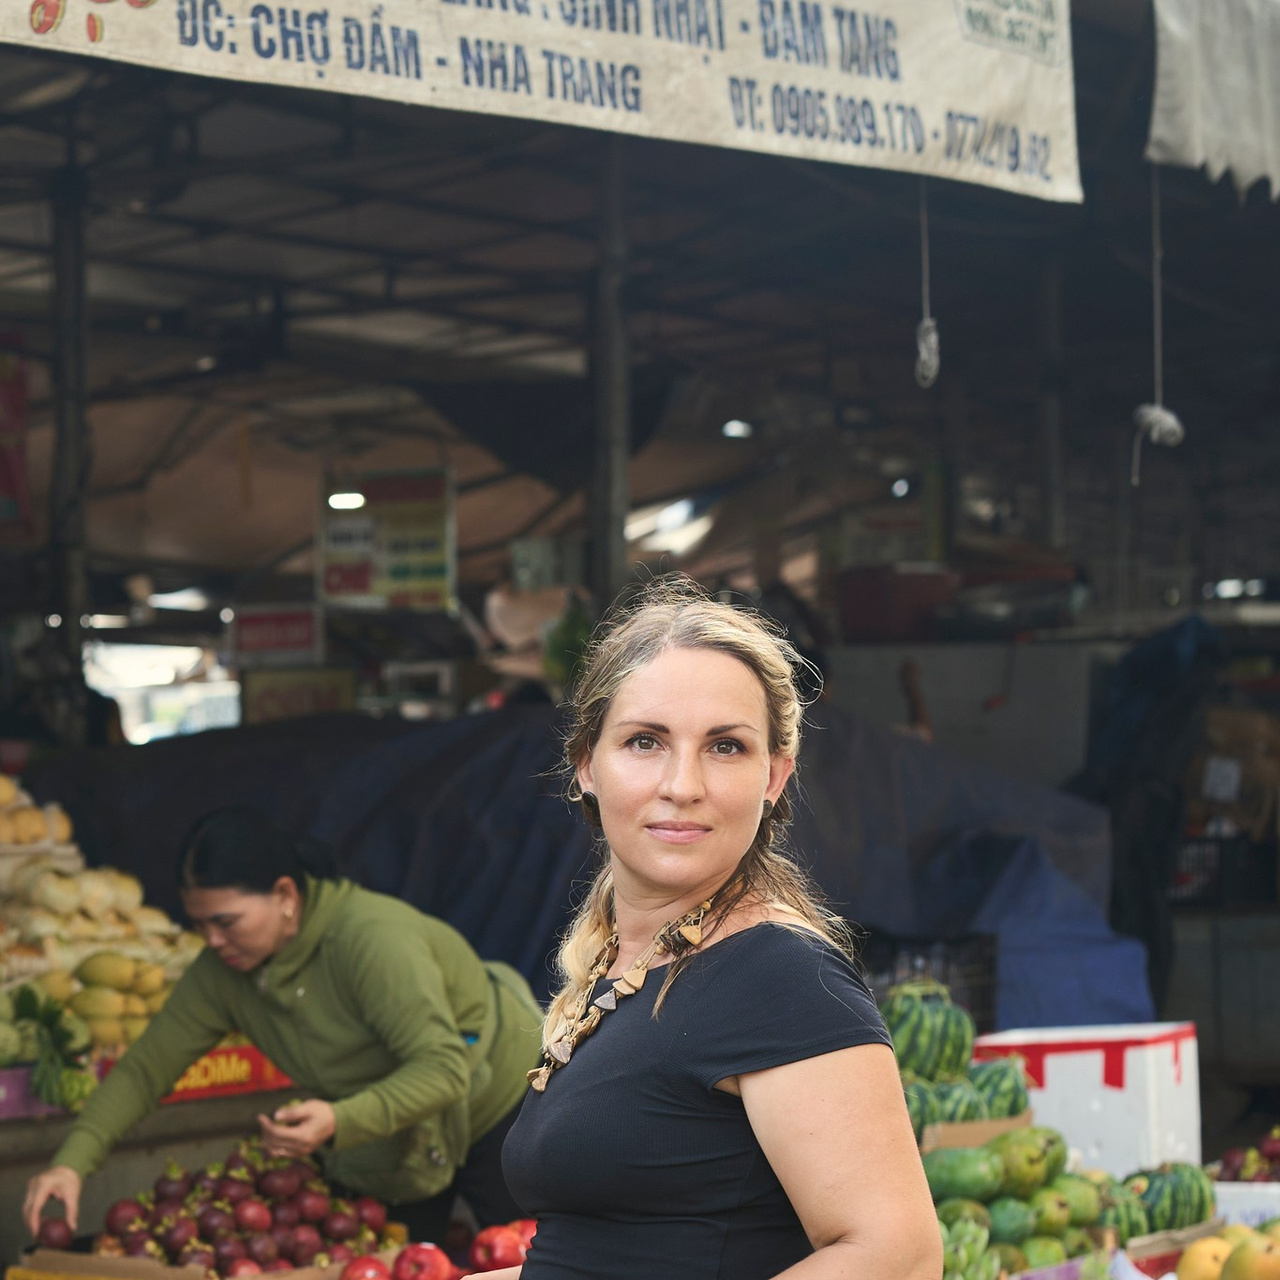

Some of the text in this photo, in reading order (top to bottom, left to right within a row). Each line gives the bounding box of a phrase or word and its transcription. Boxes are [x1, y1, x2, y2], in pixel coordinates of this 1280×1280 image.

[250, 4, 331, 78] CHỢ
[459, 36, 531, 95] NHA
[543, 49, 641, 112] TRANG
[832, 6, 900, 81] TANG
[173, 1052, 251, 1091] aDiMe
